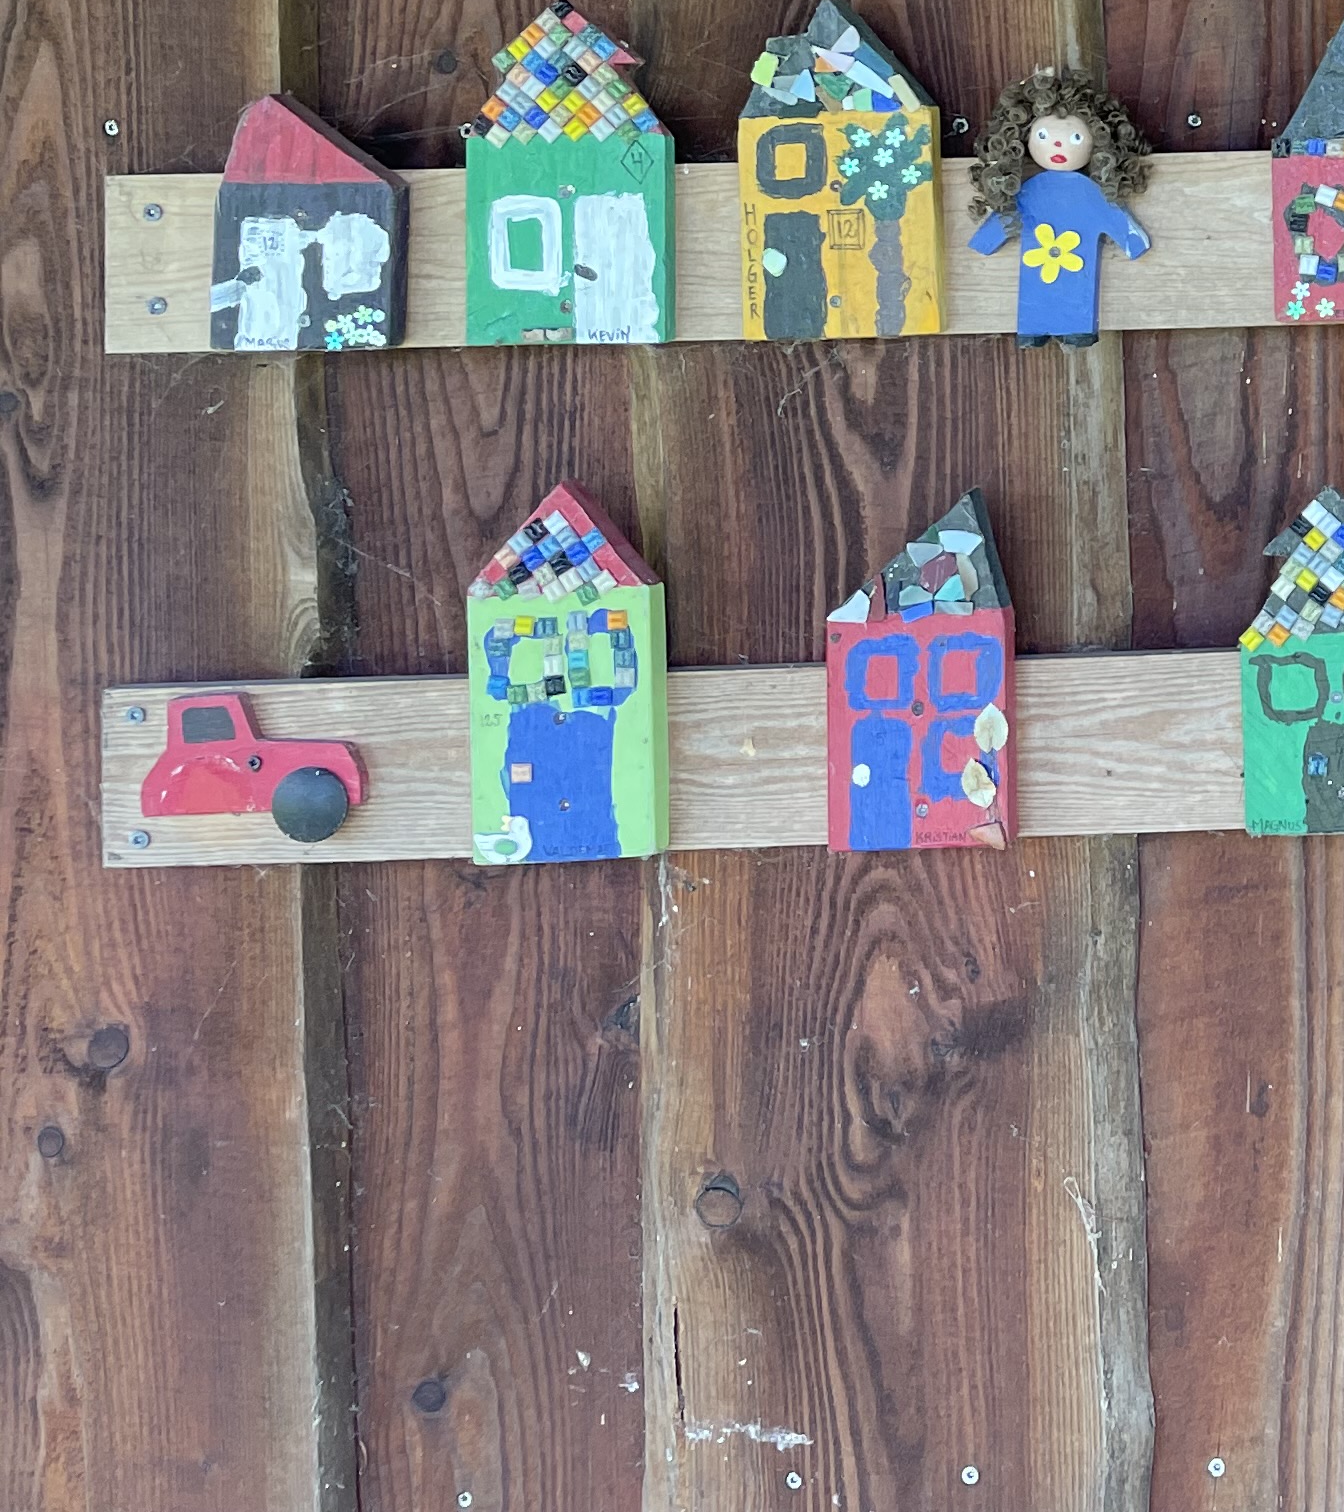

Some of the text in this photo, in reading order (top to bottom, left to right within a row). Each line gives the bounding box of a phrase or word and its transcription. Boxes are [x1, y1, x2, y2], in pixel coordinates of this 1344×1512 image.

[630, 151, 644, 174] 4
[836, 219, 854, 239] 12
[262, 236, 279, 251] 12
[744, 202, 760, 319] HOLGER
[1251, 818, 1303, 832] MAGNUS
